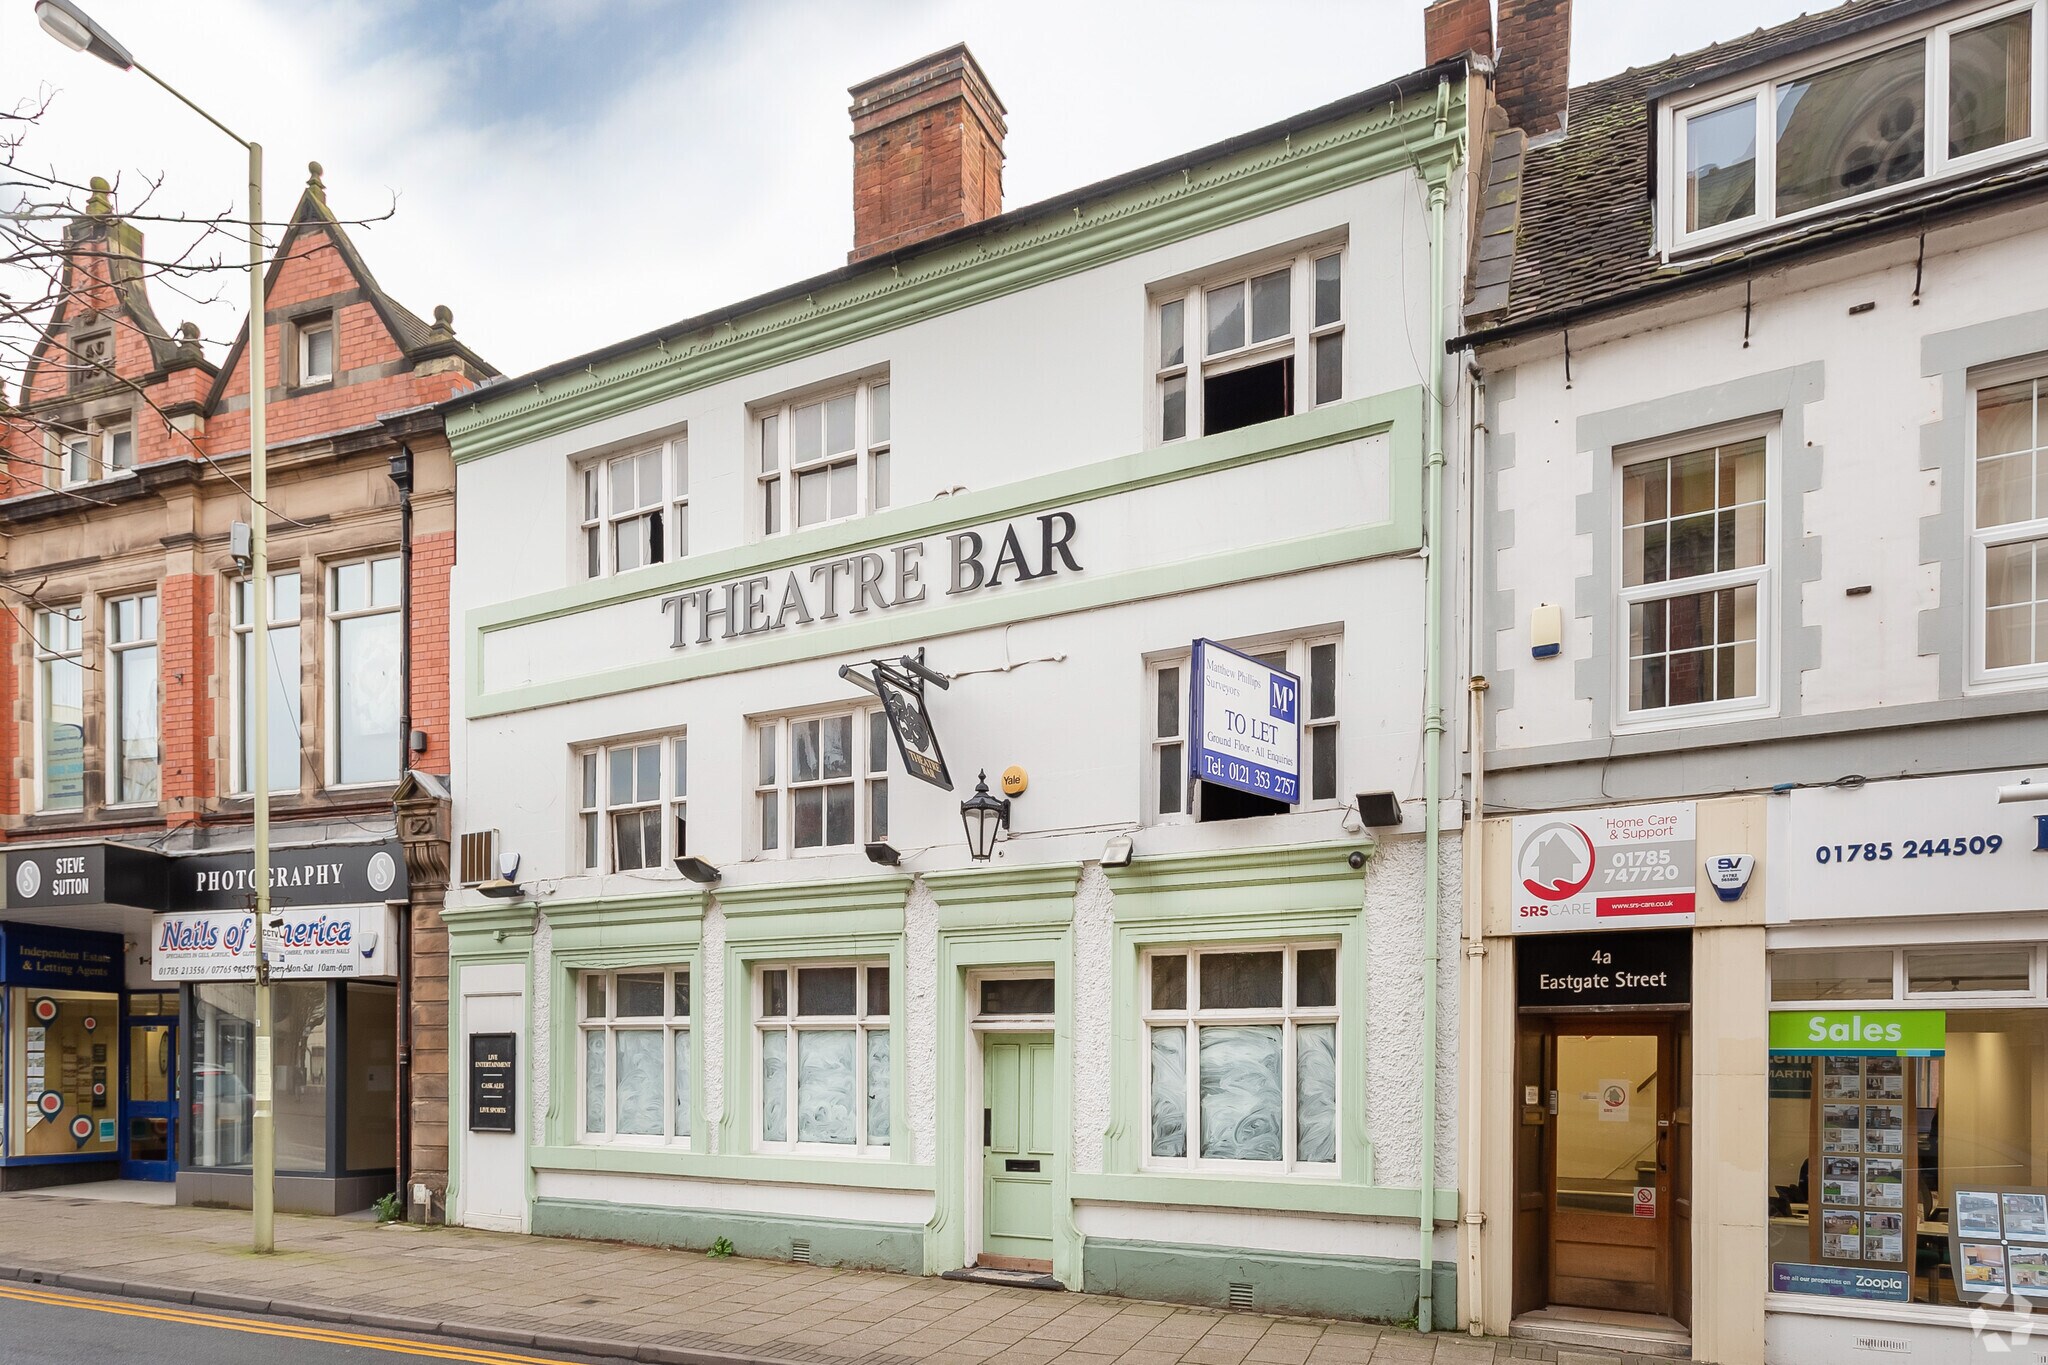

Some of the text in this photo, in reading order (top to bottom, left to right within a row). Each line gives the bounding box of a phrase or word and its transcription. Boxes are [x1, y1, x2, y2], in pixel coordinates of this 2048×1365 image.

[661, 511, 1084, 649] THEATRE BAR
[1206, 659, 1261, 689] Matthew Phillips
[1206, 675, 1240, 697] Surveyors
[1225, 709, 1278, 745] TO LET
[1207, 731, 1231, 748] Ground
[1234, 740, 1250, 753] Floor
[1255, 747, 1265, 757] All
[1267, 750, 1293, 766] Enquiries
[908, 750, 940, 771] THEATRE
[1003, 775, 1020, 785] Yale
[1205, 755, 1295, 796] Tel: 0121 353 2757
[1606, 814, 1678, 830] Home Care
[1609, 825, 1674, 840] & Support
[1816, 834, 2003, 864] 01785 244509
[56, 857, 85, 875] STEVE
[1612, 850, 1671, 868] 01785
[1604, 865, 1679, 884] 747720
[52, 877, 89, 896] SUTTON
[1611, 900, 1674, 910] www.srs-care.co.uk
[159, 920, 219, 952] Nails
[223, 917, 252, 956] of
[262, 929, 278, 938] CCTV
[19, 945, 111, 962] Independent Estate
[1591, 950, 1612, 965] 4a
[22, 960, 108, 977] & Letting Agents
[158, 967, 179, 976] 01785
[181, 966, 205, 975] 213556
[211, 965, 231, 975] 07765
[317, 963, 353, 973] 10am-6pm
[1540, 971, 1667, 993] Eastgate Street
[1808, 1015, 1902, 1042] Sales
[1811, 1277, 1842, 1285] properties
[1856, 1275, 1902, 1290] Zoopla
